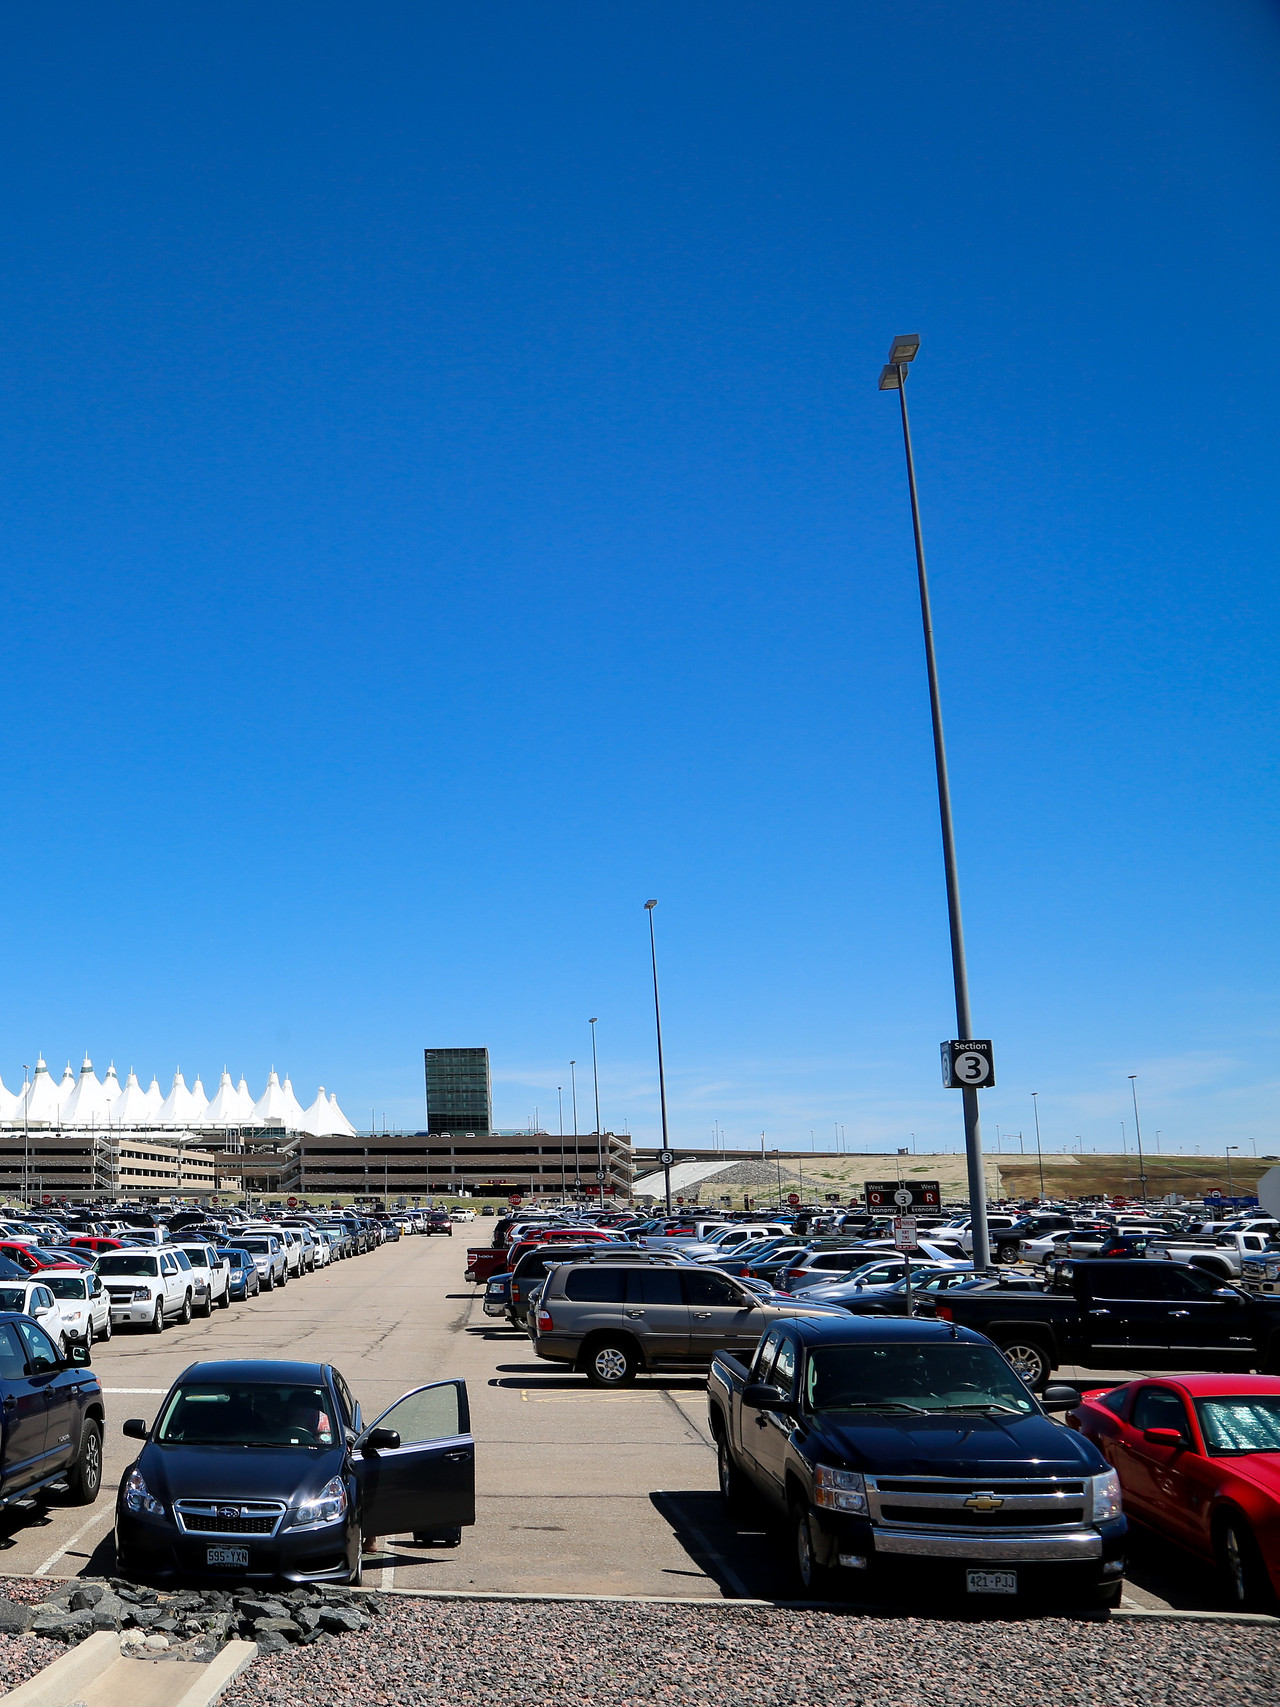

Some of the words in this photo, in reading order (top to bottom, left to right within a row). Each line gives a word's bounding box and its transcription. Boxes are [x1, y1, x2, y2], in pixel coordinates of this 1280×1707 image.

[955, 1042, 988, 1050] Section
[965, 1056, 982, 1079] 3
[871, 1193, 881, 1204] Q
[900, 1195, 907, 1205] 3
[925, 1193, 934, 1202] R
